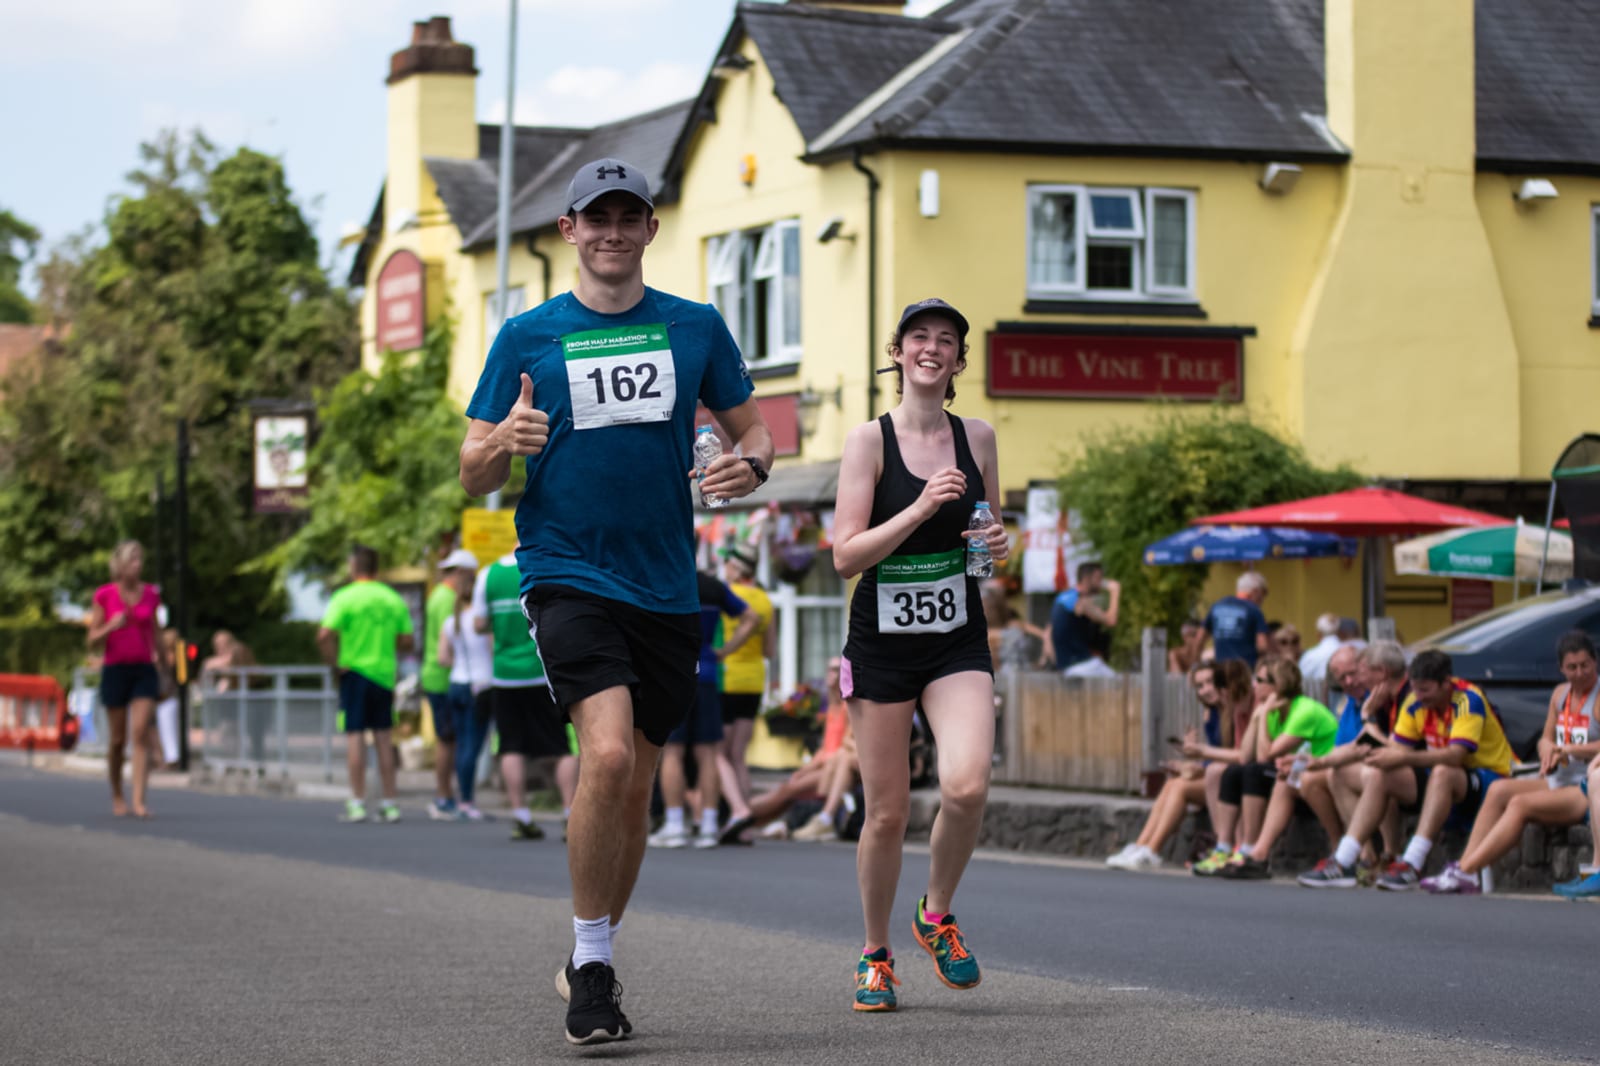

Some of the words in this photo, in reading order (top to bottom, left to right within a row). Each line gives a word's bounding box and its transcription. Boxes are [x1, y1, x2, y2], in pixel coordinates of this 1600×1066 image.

[609, 334, 647, 344] MARATHON
[1003, 347, 1065, 378] THE
[1076, 350, 1145, 380] VINE
[1155, 351, 1226, 382] TREE
[587, 362, 661, 404] 162
[918, 561, 949, 570] MARATHON
[893, 588, 956, 627] 358
